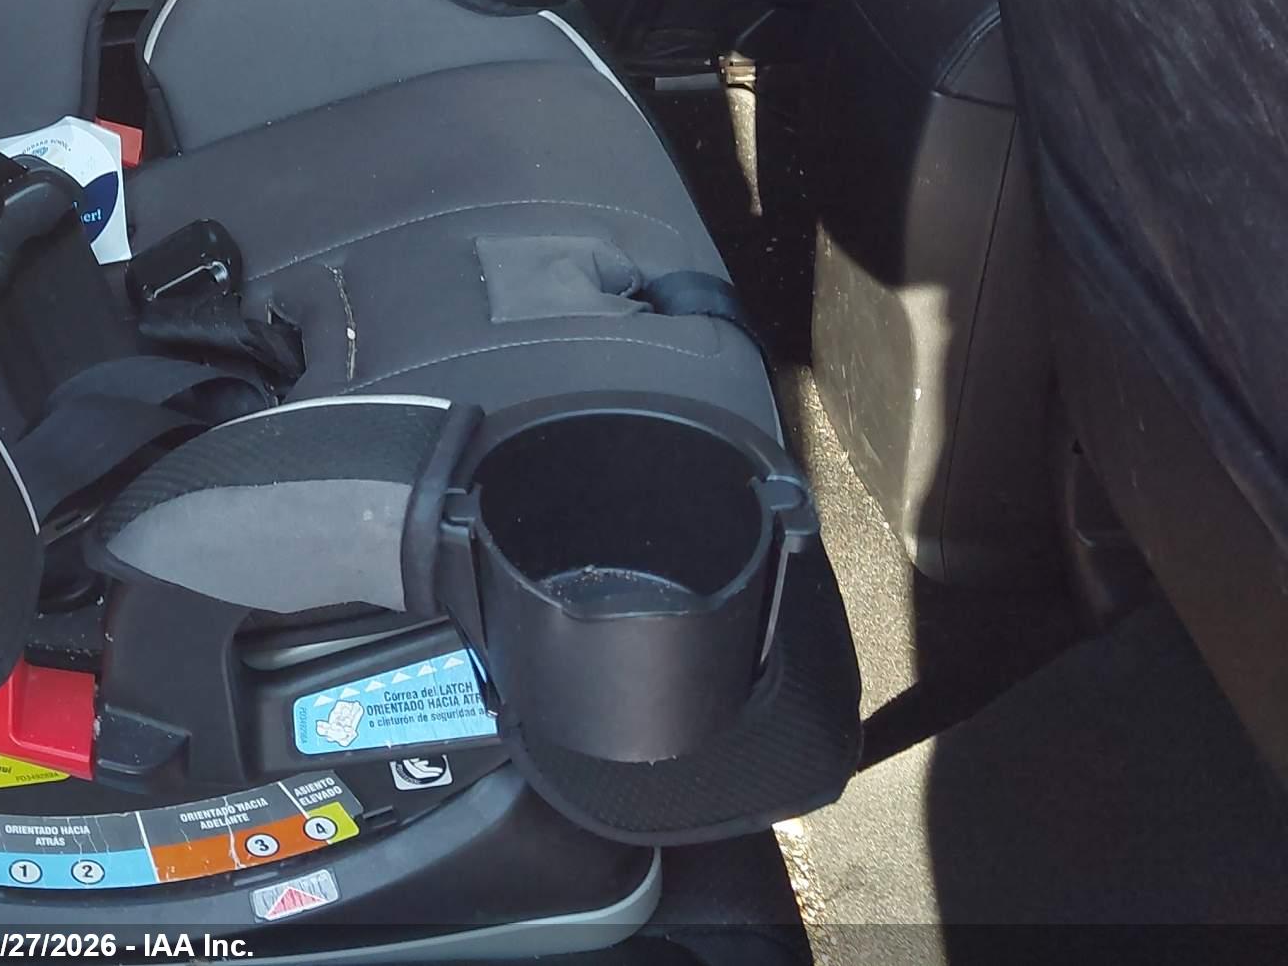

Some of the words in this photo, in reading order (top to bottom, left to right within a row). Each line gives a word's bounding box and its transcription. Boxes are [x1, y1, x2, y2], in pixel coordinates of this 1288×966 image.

[384, 689, 418, 701] Correa
[421, 687, 436, 697] del
[439, 682, 473, 695] LATCH
[367, 701, 424, 716] ORIENTADO
[428, 696, 460, 708] HACIA
[377, 714, 415, 727] cinturón
[417, 712, 428, 722] de
[431, 708, 476, 722] seguridad
[294, 776, 336, 797] ASIENTO
[298, 786, 343, 806] ELEVADO
[180, 805, 236, 823] ORIENTADO
[238, 797, 269, 813] HACIA
[5, 824, 59, 835] ORIENTADO
[61, 825, 90, 835] HACIA
[200, 813, 250, 830] ADELANTE
[315, 822, 327, 835] 4
[35, 836, 66, 847] ATRÁS
[254, 838, 269, 853] 3
[19, 865, 29, 878] 1
[82, 865, 94, 878] 2
